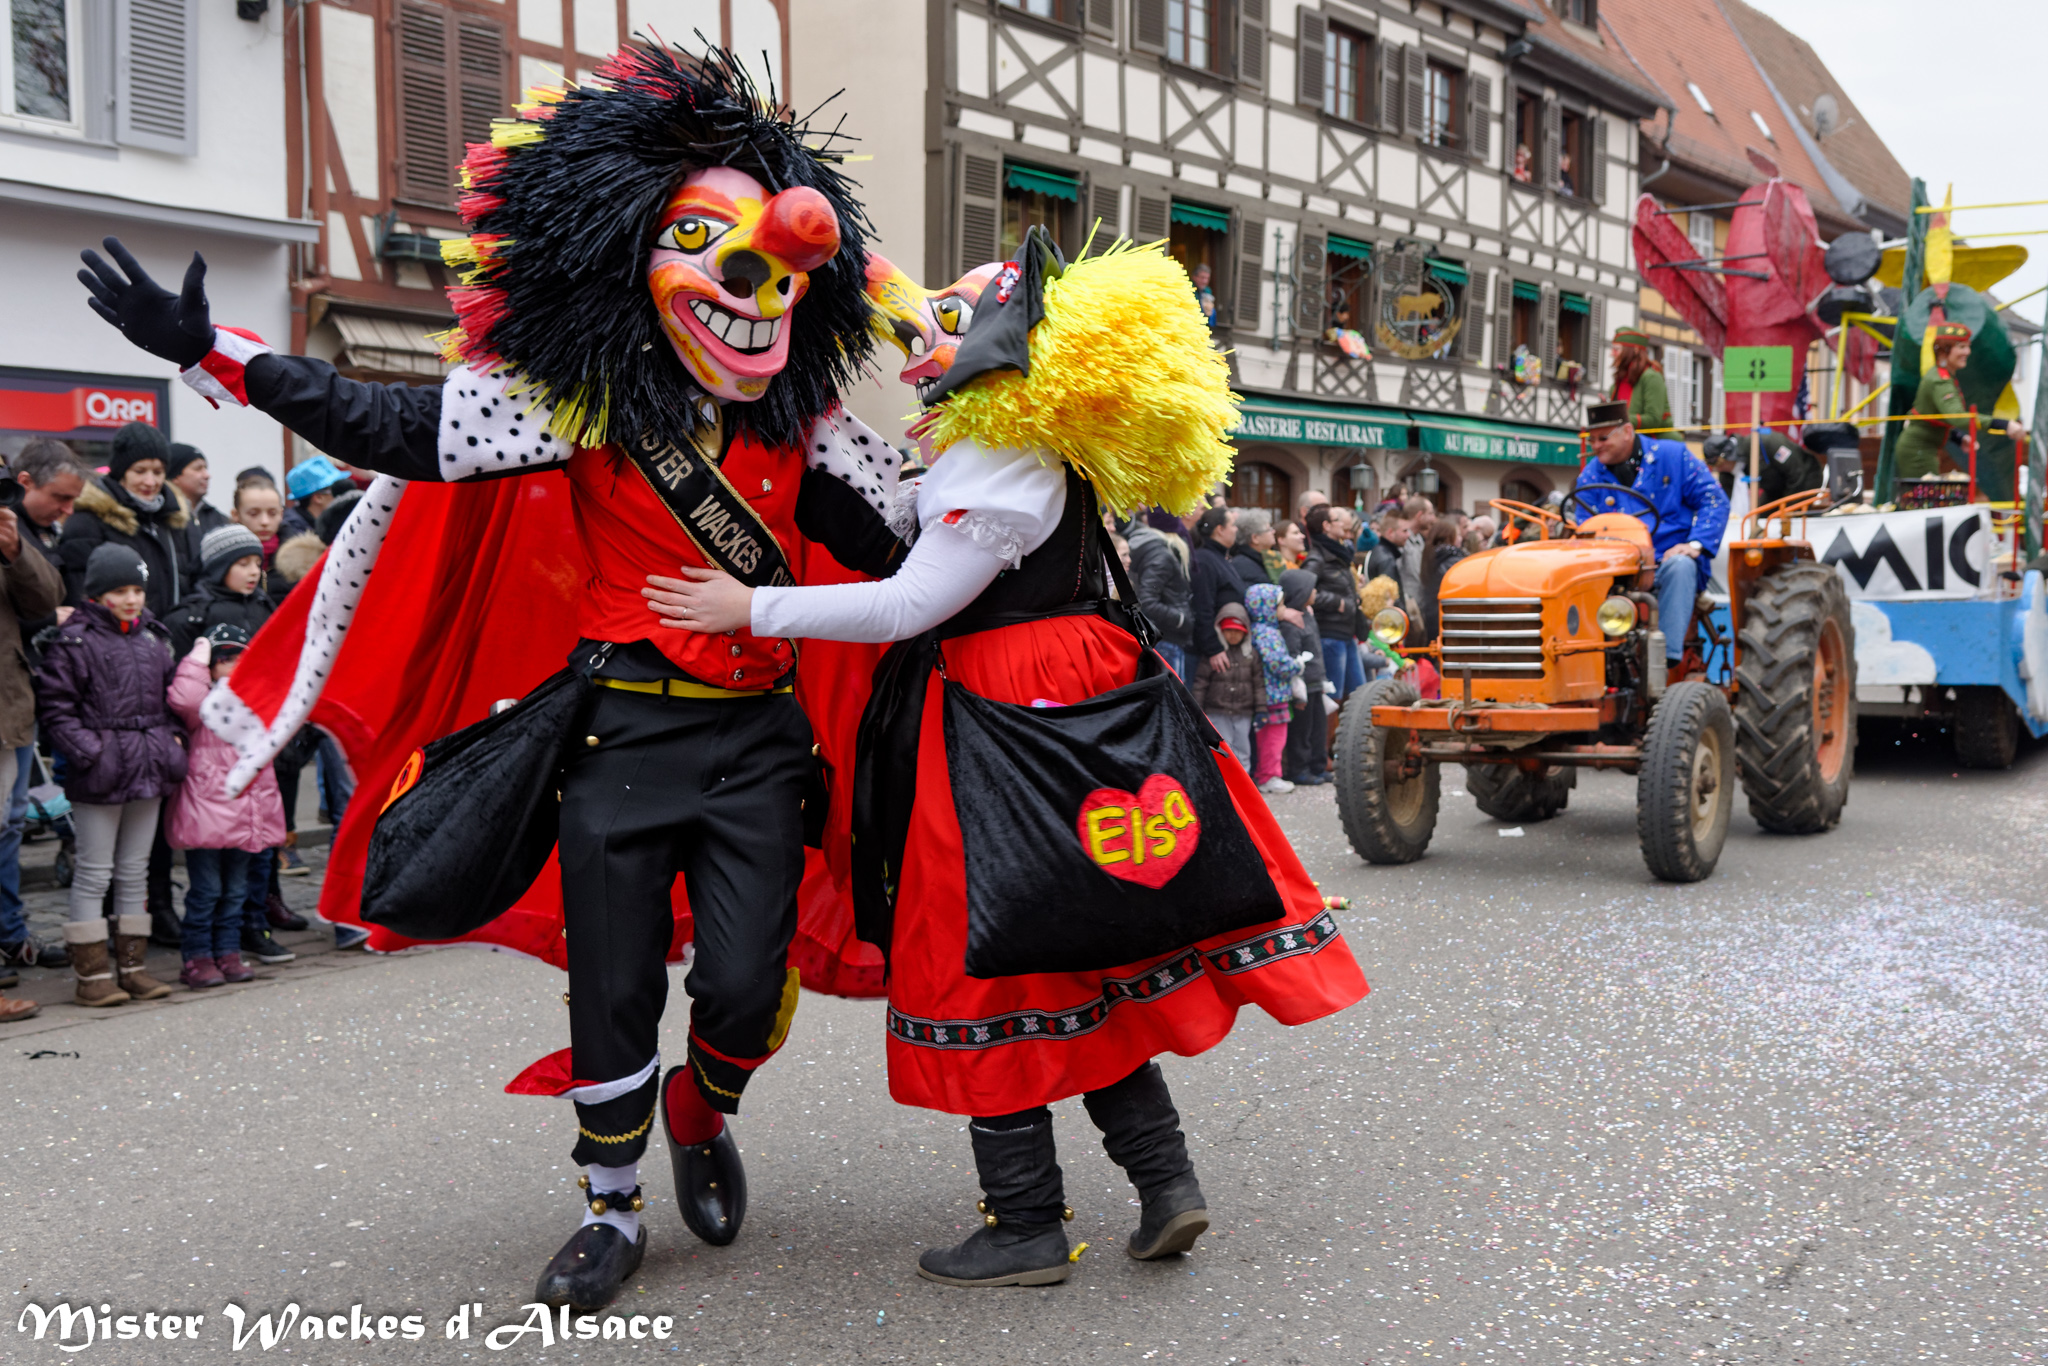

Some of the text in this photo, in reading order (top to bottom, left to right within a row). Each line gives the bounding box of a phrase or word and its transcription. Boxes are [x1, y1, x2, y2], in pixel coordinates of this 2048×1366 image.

[1749, 359, 1766, 380] 8
[86, 391, 153, 422] ORPI
[1226, 414, 1384, 446] RASSERIE RESTAURANT
[1444, 432, 1460, 451] AU
[1463, 435, 1488, 453] PIED
[689, 494, 762, 574] WACKES
[1087, 790, 1196, 865] Elsa
